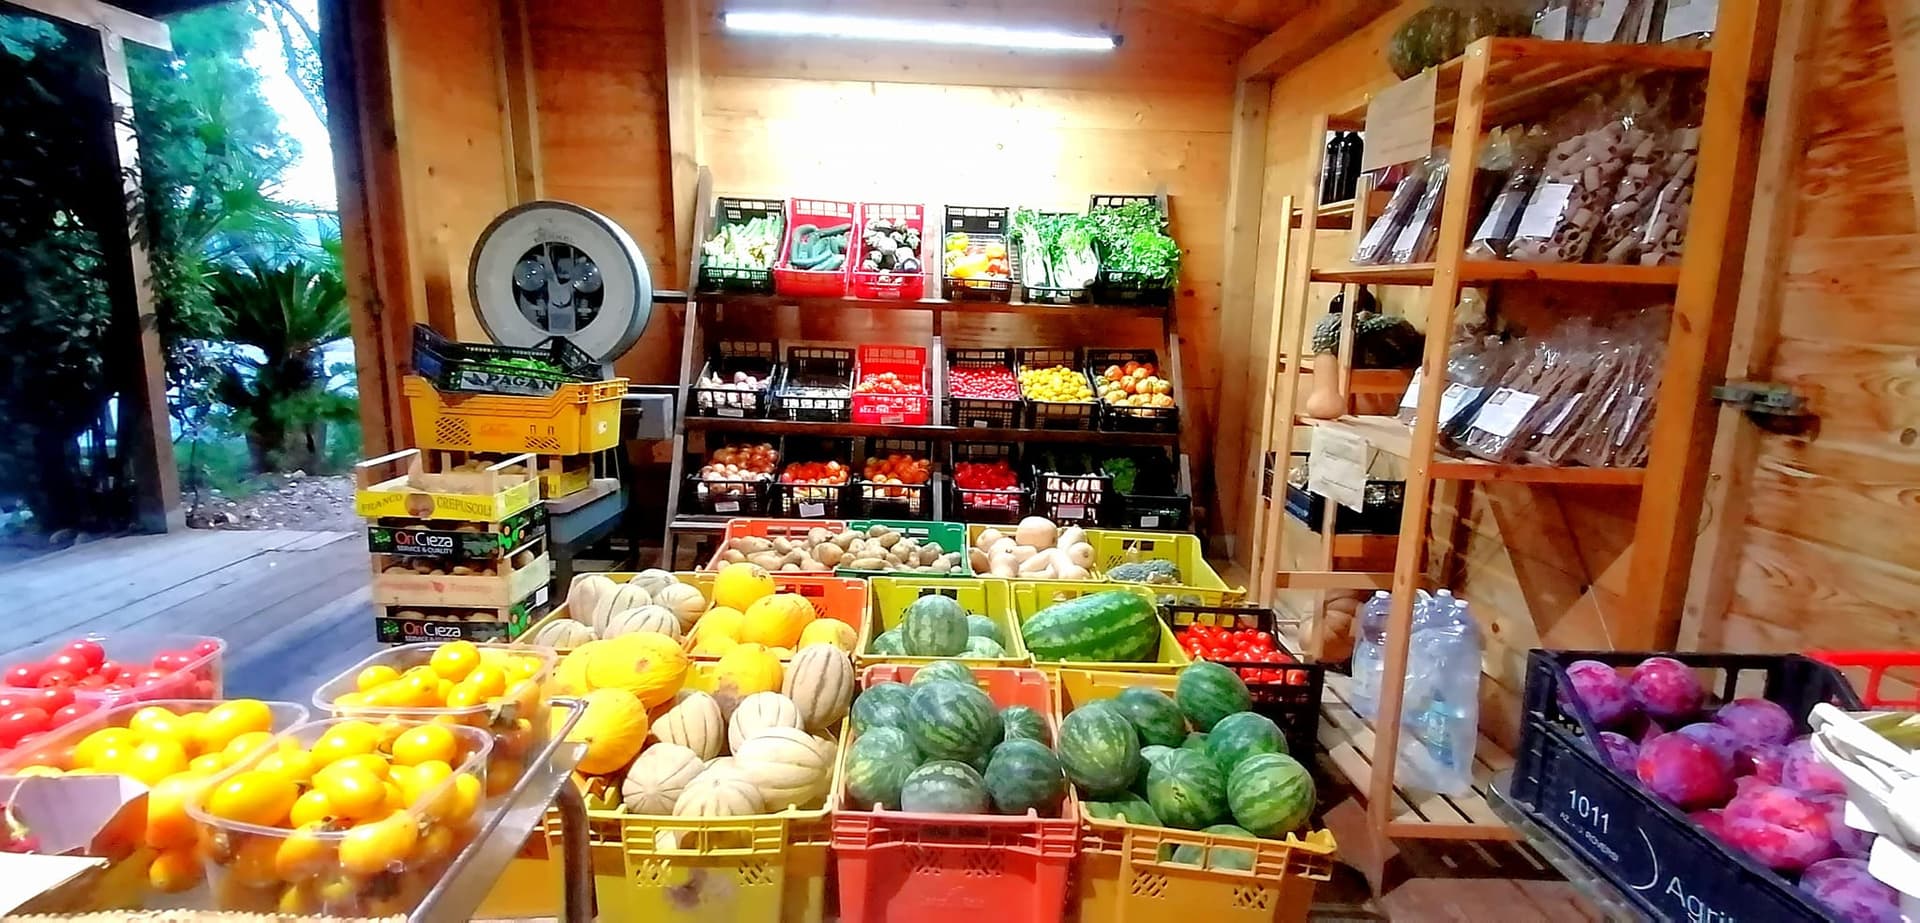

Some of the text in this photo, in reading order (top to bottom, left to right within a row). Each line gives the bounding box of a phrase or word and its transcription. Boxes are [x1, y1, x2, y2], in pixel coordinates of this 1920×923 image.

[361, 494, 403, 512] FRANCO
[436, 496, 492, 517] CREPUSCOLI
[397, 545, 420, 553] SERVICE
[1569, 789, 1609, 834] 1011
